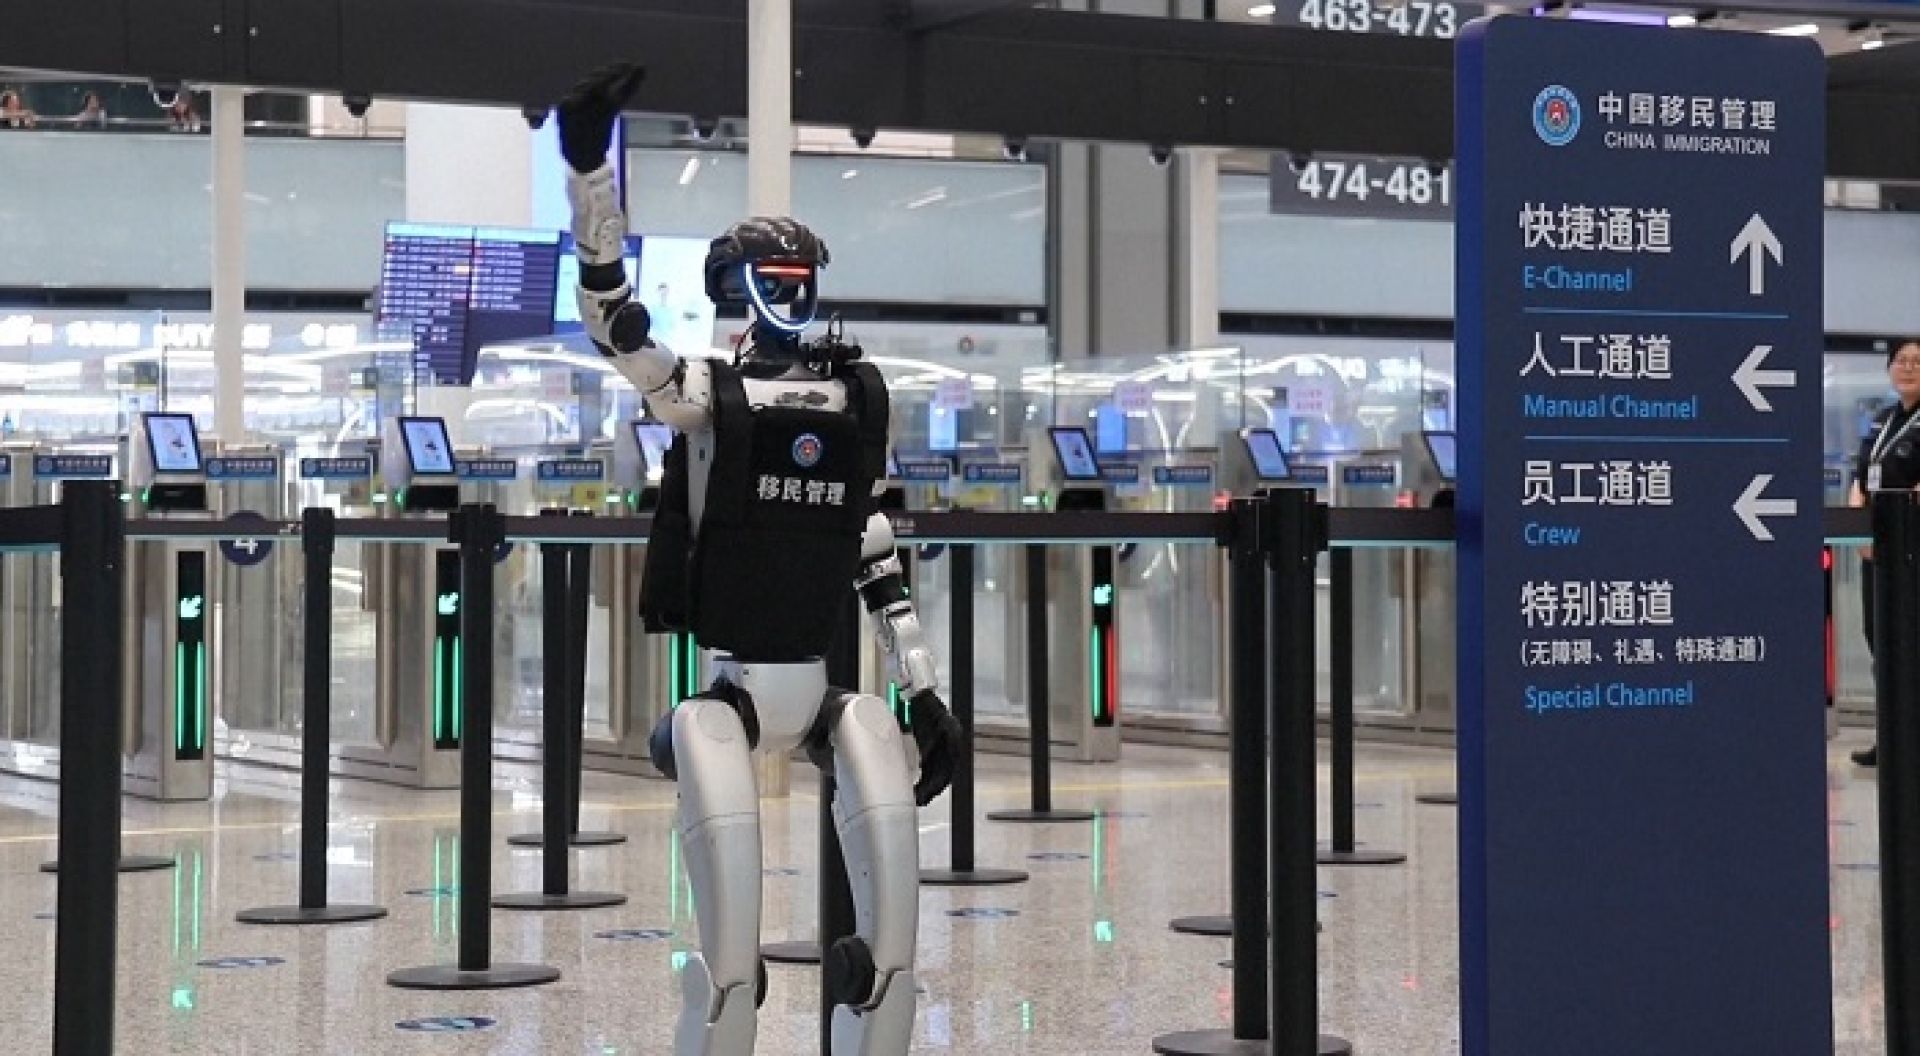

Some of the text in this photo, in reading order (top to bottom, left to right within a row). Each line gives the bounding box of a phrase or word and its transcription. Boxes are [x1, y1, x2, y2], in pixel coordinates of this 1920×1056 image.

[1299, 0, 1457, 38] 463-473
[1598, 90, 1776, 131] 中国移民管理
[1604, 131, 1770, 155] CHINA IMMIGRATION
[1297, 161, 1449, 206] 474-481
[1519, 202, 1672, 253] 快捷通道
[1524, 265, 1633, 292] E-Channel
[1519, 331, 1672, 380] 人工通道
[1524, 394, 1697, 419] Manual Channel
[757, 474, 846, 506] 移民管理
[1521, 460, 1674, 506] 员工通道
[1524, 522, 1581, 546] Crew
[1521, 580, 1674, 628] 特别通道
[1524, 681, 1694, 714] Special Channel
